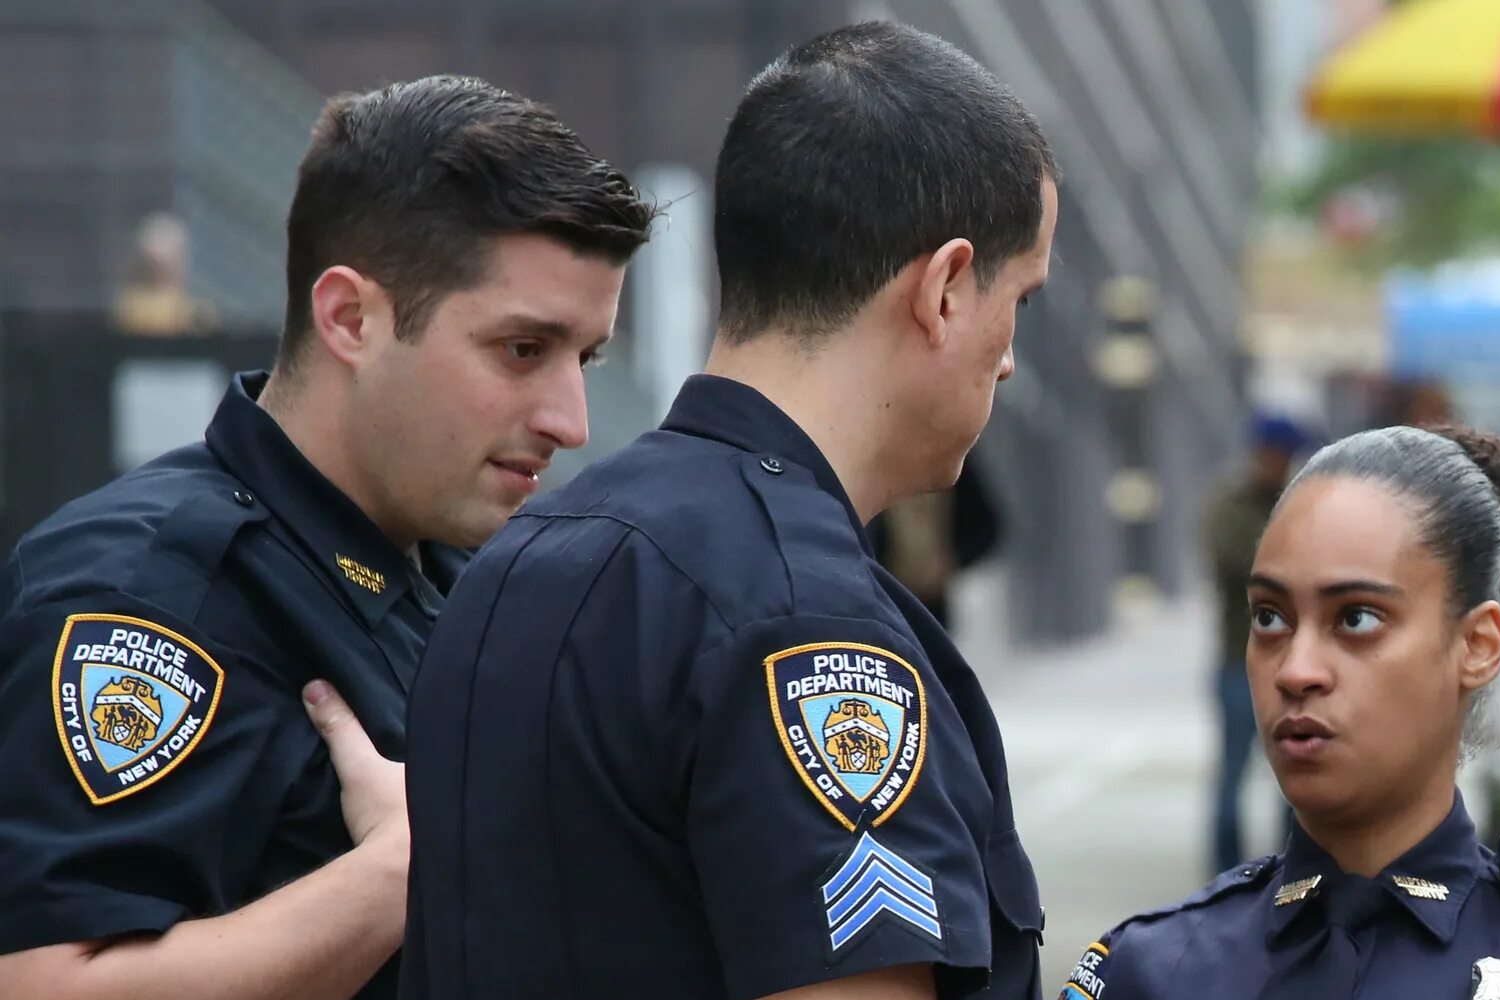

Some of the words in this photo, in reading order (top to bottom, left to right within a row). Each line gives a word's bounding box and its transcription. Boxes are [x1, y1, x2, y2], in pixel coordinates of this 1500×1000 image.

[109, 628, 188, 669] POLICE
[813, 653, 889, 679] POLICE
[72, 644, 207, 703] DEPARTMENT
[786, 672, 914, 709] DEPARTMENT
[61, 682, 82, 730] CITY
[71, 734, 92, 763] OF
[158, 714, 202, 760] YORK
[117, 755, 160, 786] NEW
[787, 724, 821, 771] CITY
[816, 773, 844, 800] OF
[870, 772, 904, 811] NEW
[896, 721, 920, 773] YORK
